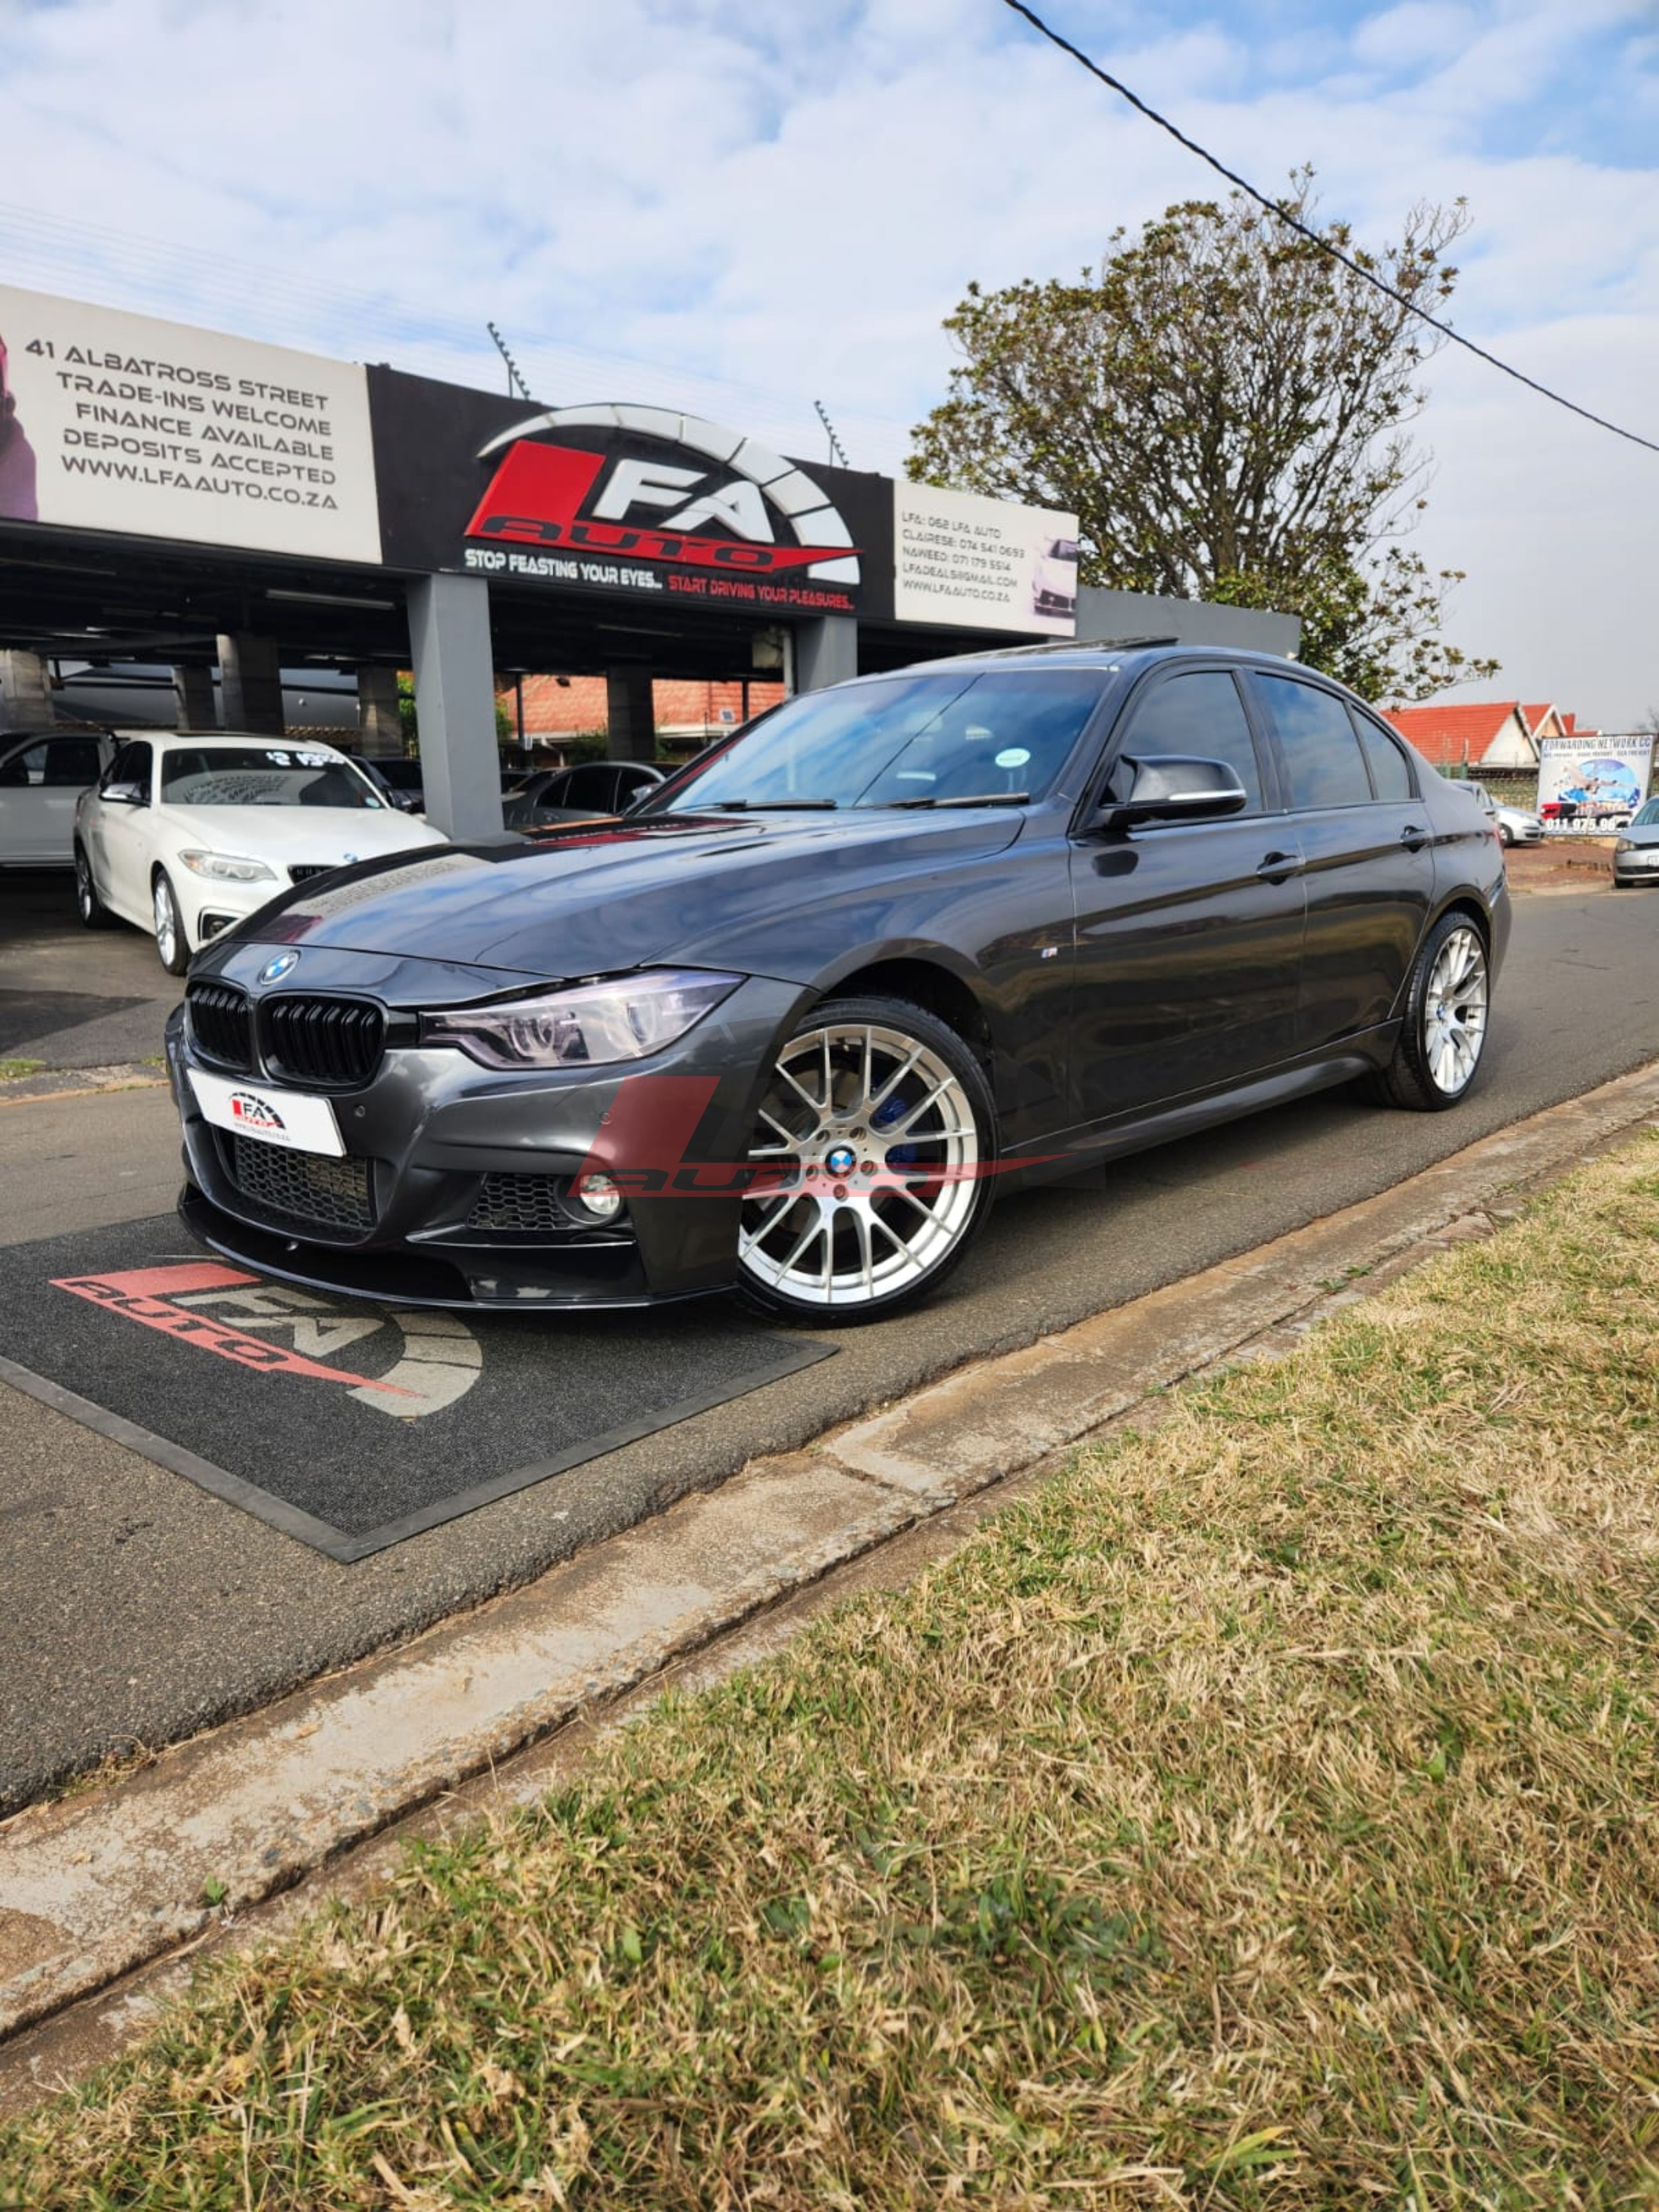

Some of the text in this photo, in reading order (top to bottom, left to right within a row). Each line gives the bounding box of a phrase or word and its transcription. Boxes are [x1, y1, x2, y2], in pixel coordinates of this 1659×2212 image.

[25, 339, 329, 411] 41 ALBATROSS STREET
[56, 371, 331, 436] TRADE-INS WELCOME
[76, 402, 334, 461] FINANCE AVAILABLE
[62, 455, 339, 510] WWW.LFAAUTO.CO.ZA
[63, 428, 336, 485] DEPOSITS ACCEPTED
[481, 515, 774, 566] AUTO
[974, 525, 1002, 539] AUTO
[465, 548, 507, 570] STOP
[509, 554, 577, 579] FEASTING
[580, 563, 618, 585] YOUR
[667, 575, 708, 594] START
[710, 578, 755, 599] DRIVING
[757, 585, 787, 603] YOUR
